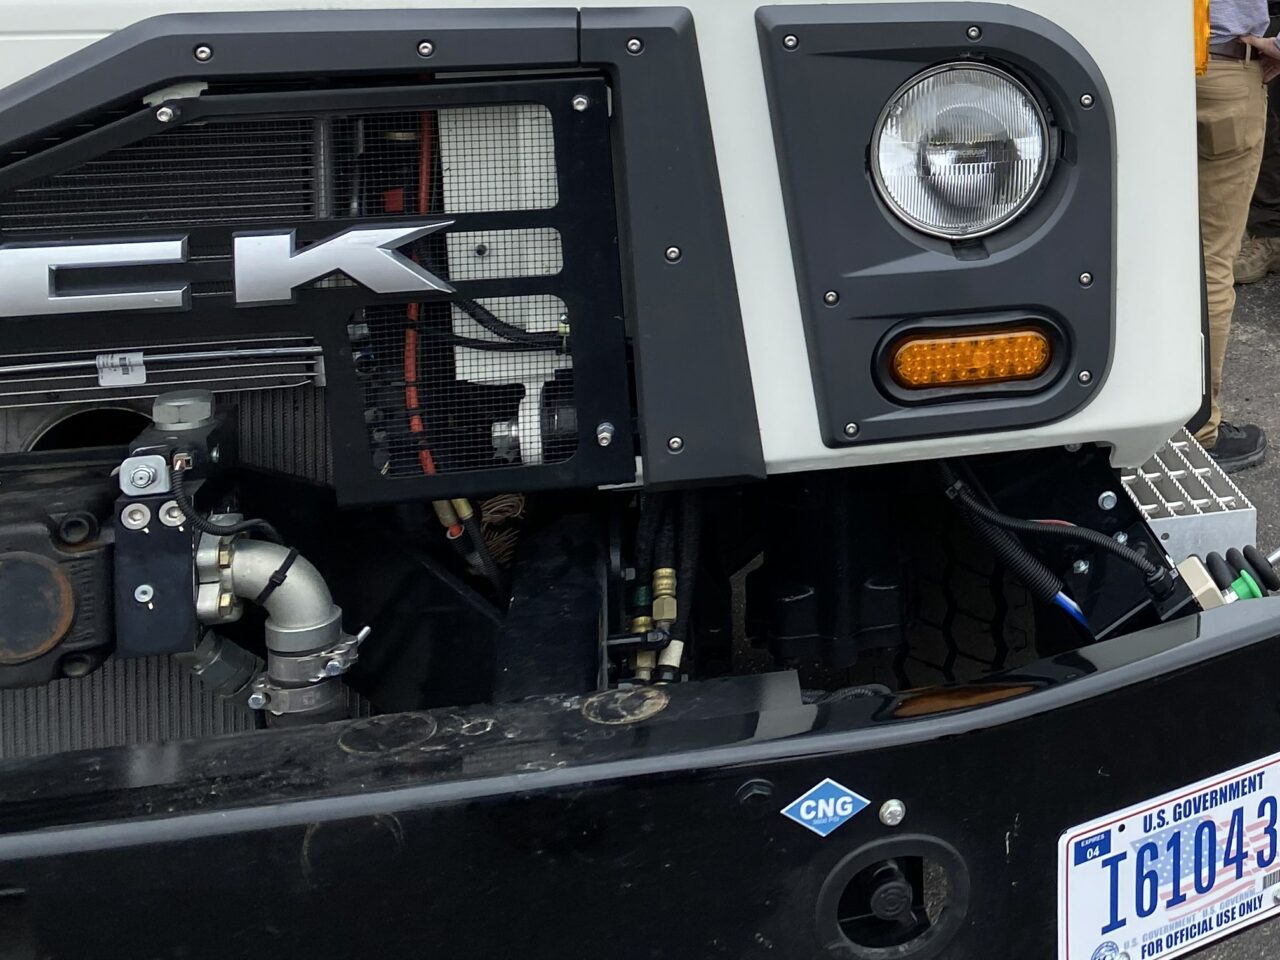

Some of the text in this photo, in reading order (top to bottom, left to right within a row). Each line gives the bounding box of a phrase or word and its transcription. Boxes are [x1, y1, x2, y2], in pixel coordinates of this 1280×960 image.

[800, 795, 853, 820] CNG
[1143, 771, 1265, 834] U.S. GOVERNMENT
[1080, 833, 1105, 848] EXPIRES
[1086, 845, 1100, 859] 04
[1141, 937, 1163, 960] FOR
[1165, 916, 1214, 949] OFFICIAL
[1216, 905, 1237, 928] USE
[1238, 893, 1264, 917] ONLY
